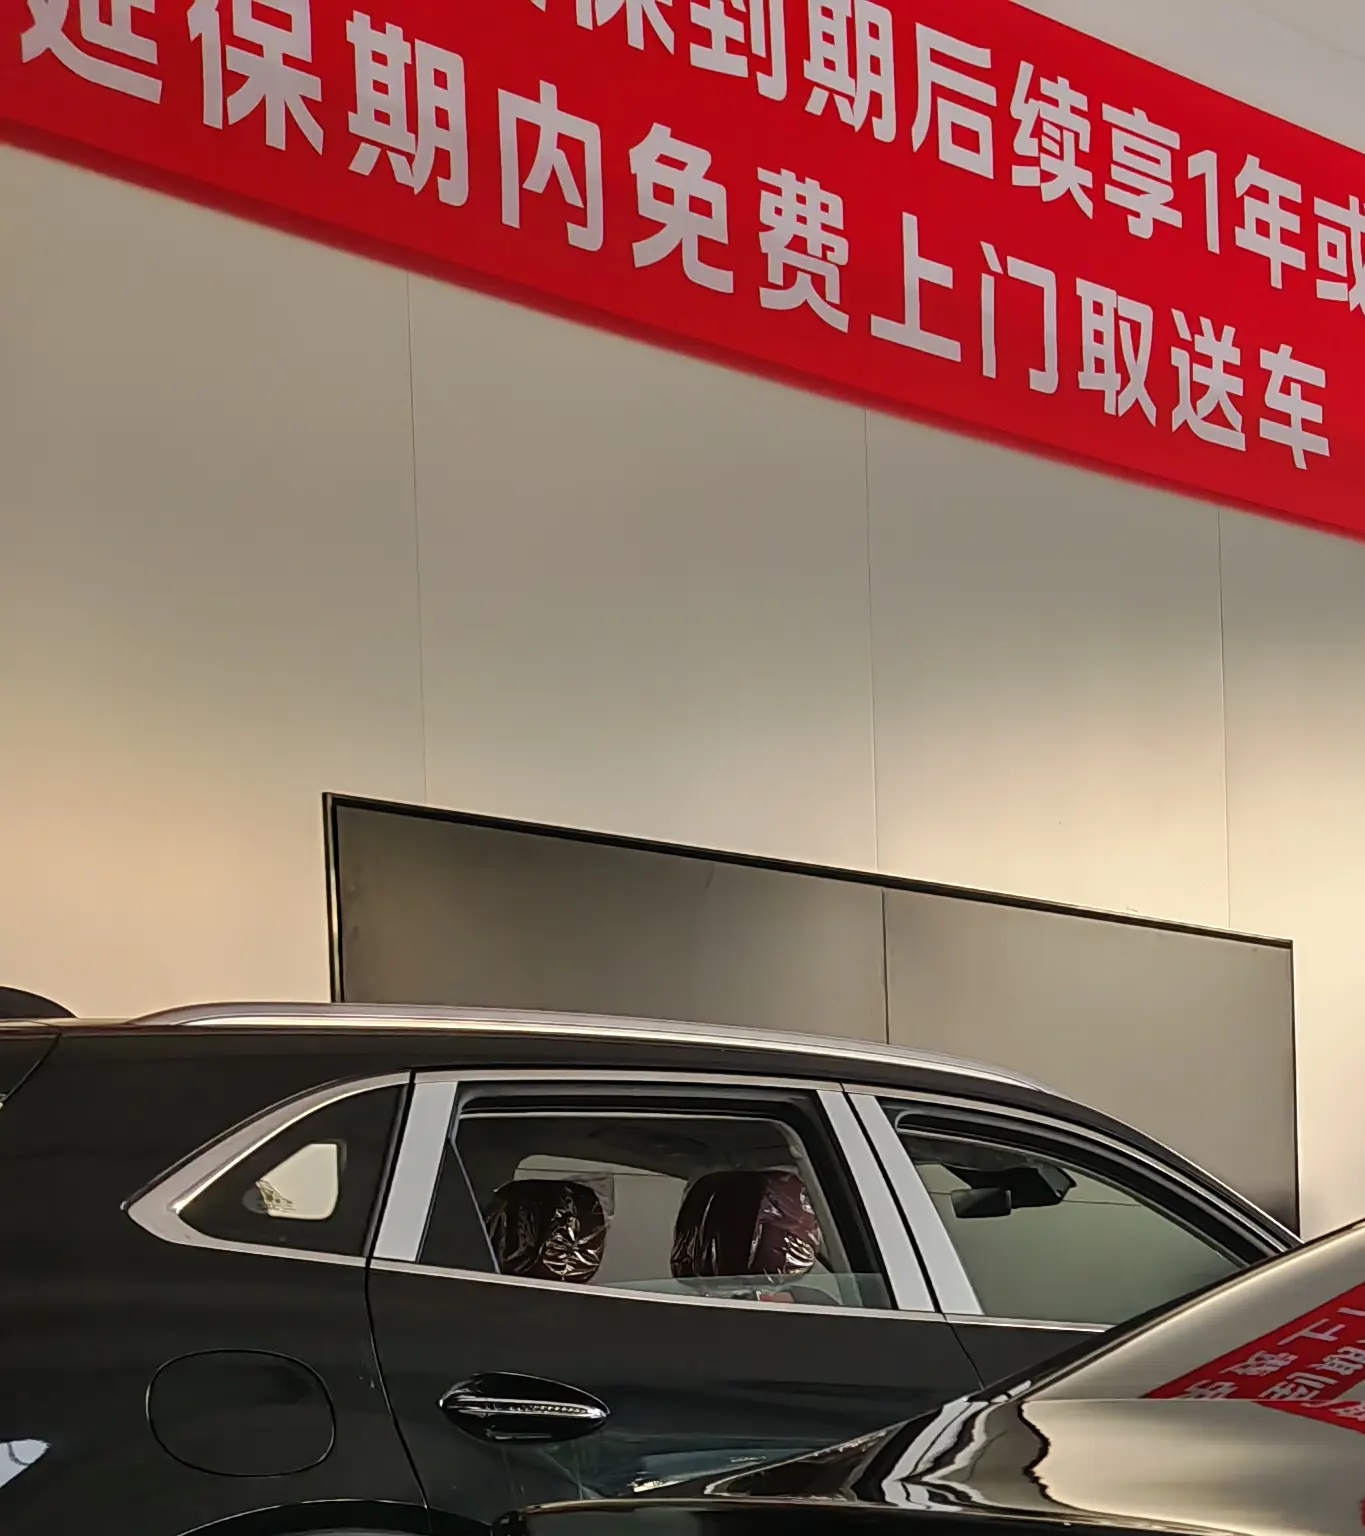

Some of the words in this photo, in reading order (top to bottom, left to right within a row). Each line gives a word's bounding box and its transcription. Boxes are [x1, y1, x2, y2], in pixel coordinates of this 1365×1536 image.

[20, 0, 1330, 470] 延保期内免费上门取送车
